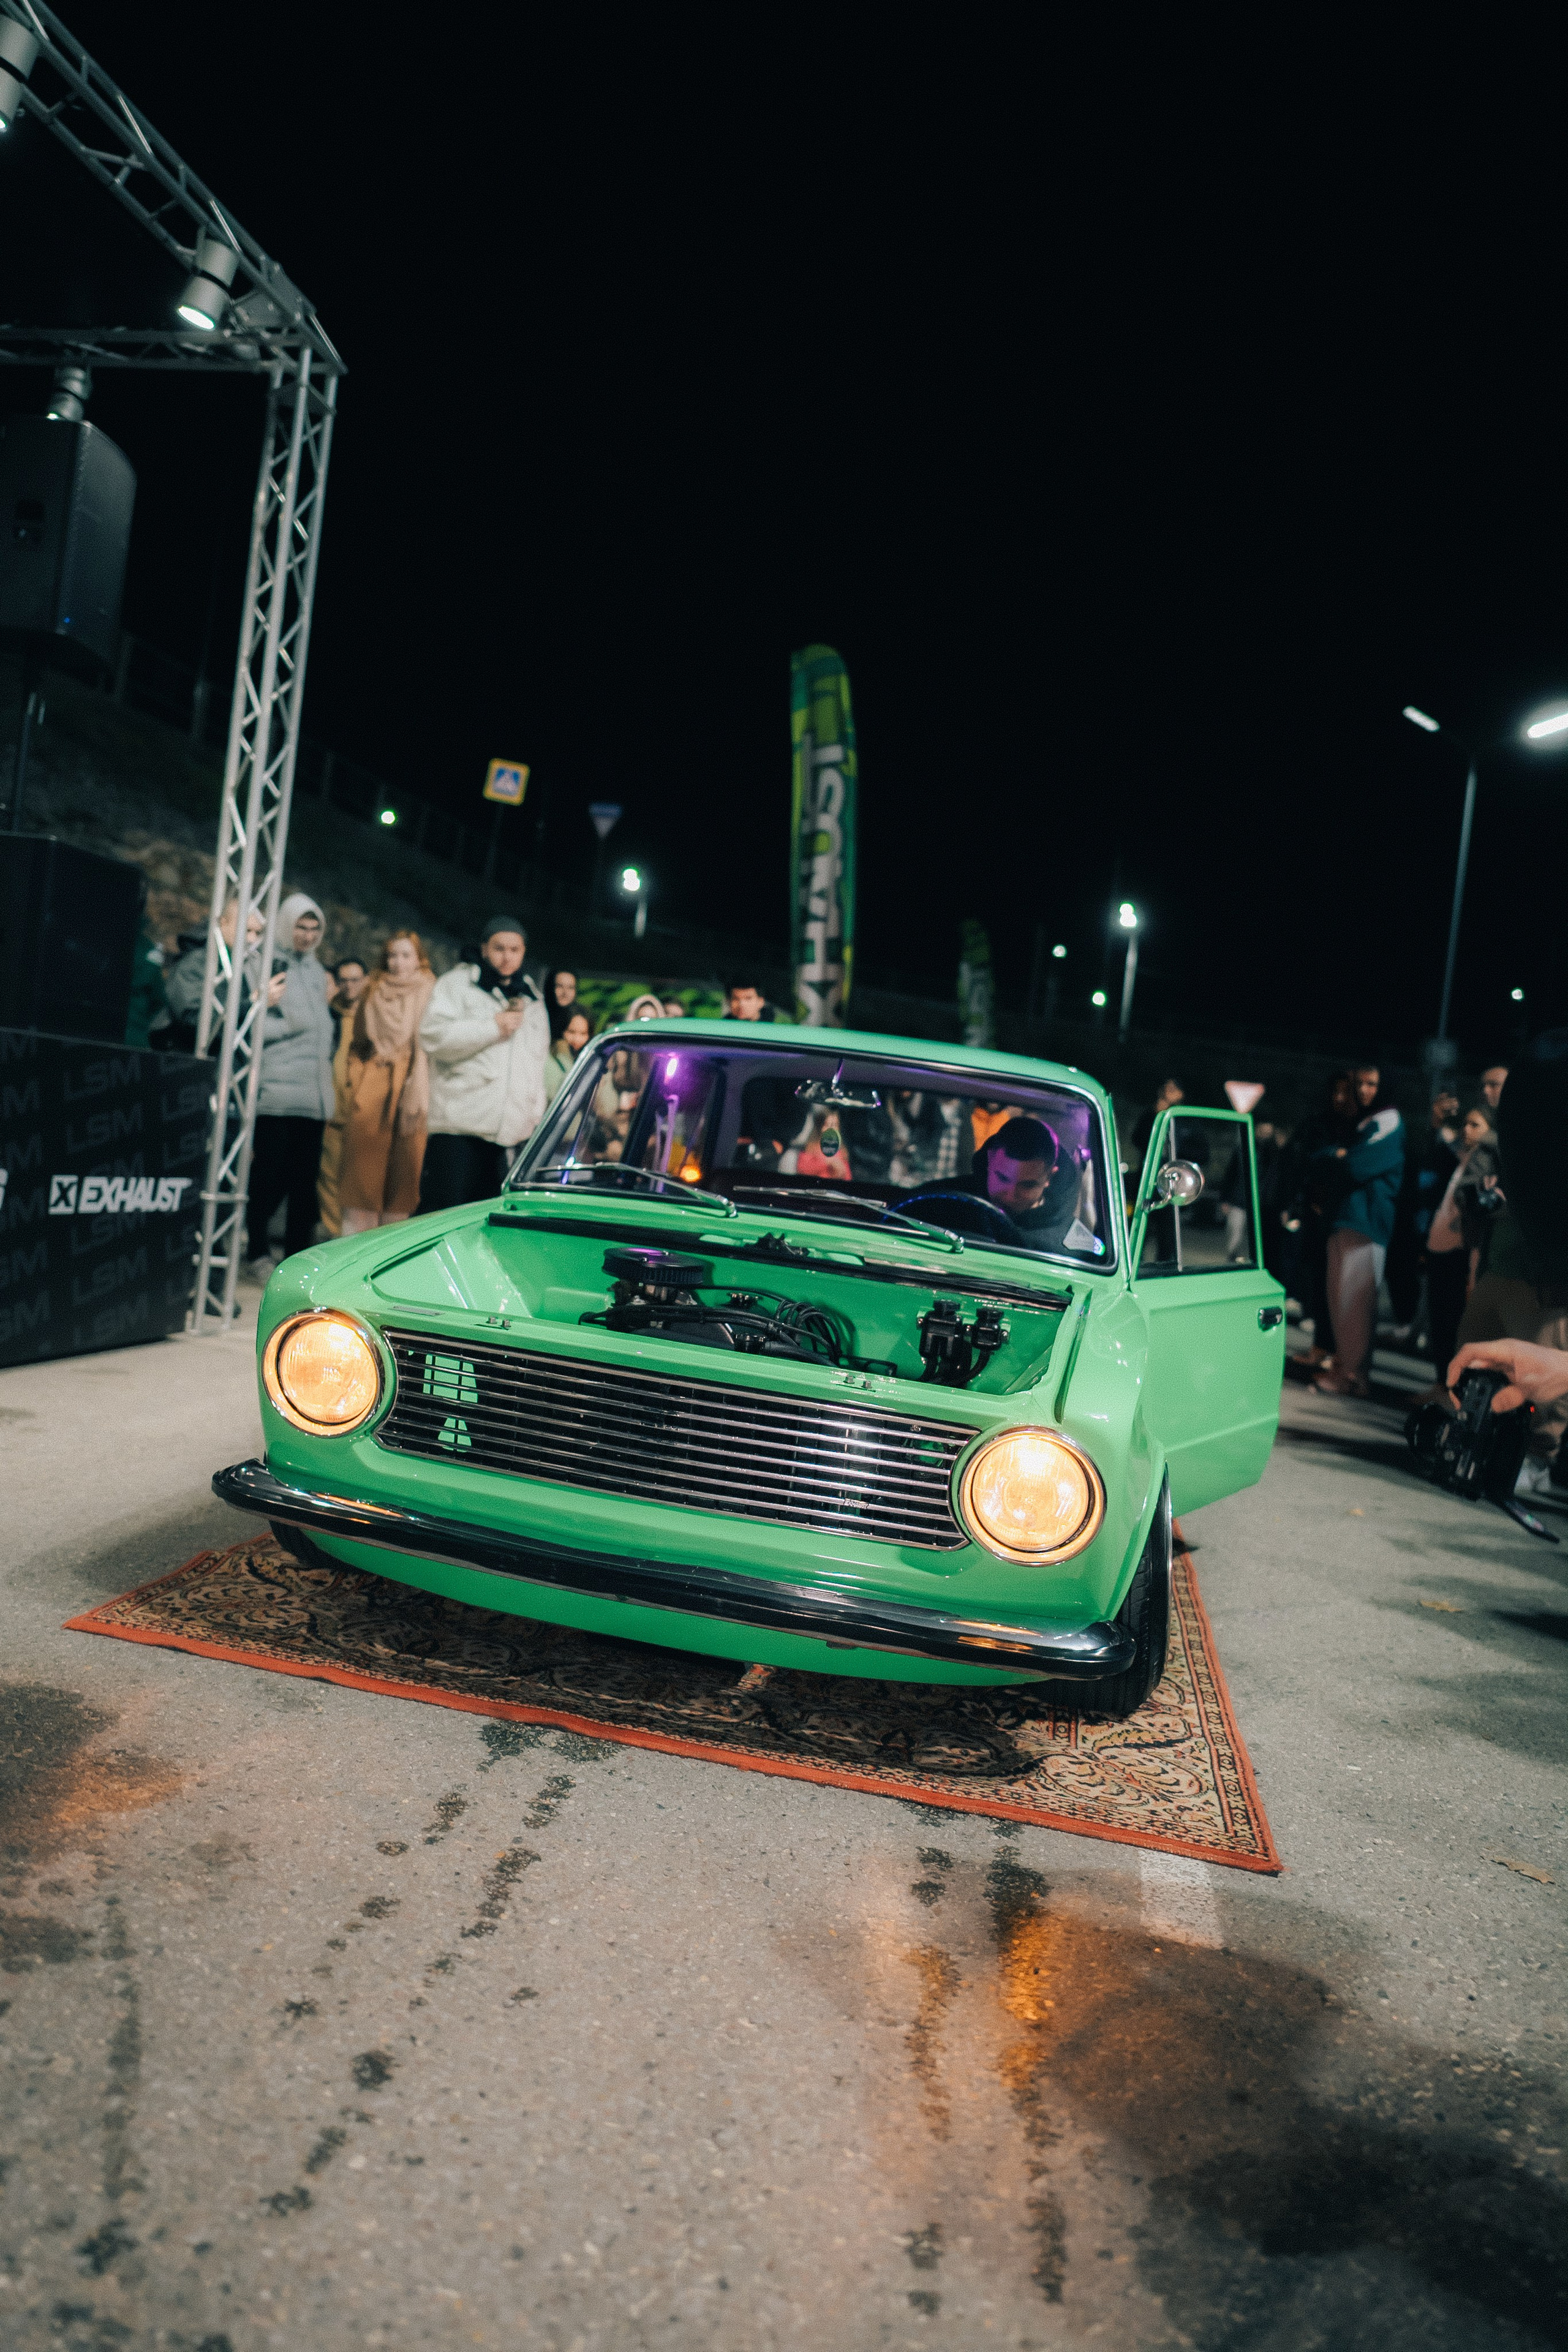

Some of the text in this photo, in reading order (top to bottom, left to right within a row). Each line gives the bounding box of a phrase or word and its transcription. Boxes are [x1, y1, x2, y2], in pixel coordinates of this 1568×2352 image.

[797, 732, 845, 1027] XHAUST
[63, 1053, 141, 1101] LSM
[66, 1102, 144, 1155] LSM
[162, 1129, 207, 1170] LS
[78, 1176, 192, 1213] EXHAUST
[72, 1246, 148, 1307] LSM
[0, 1290, 50, 1343] SM
